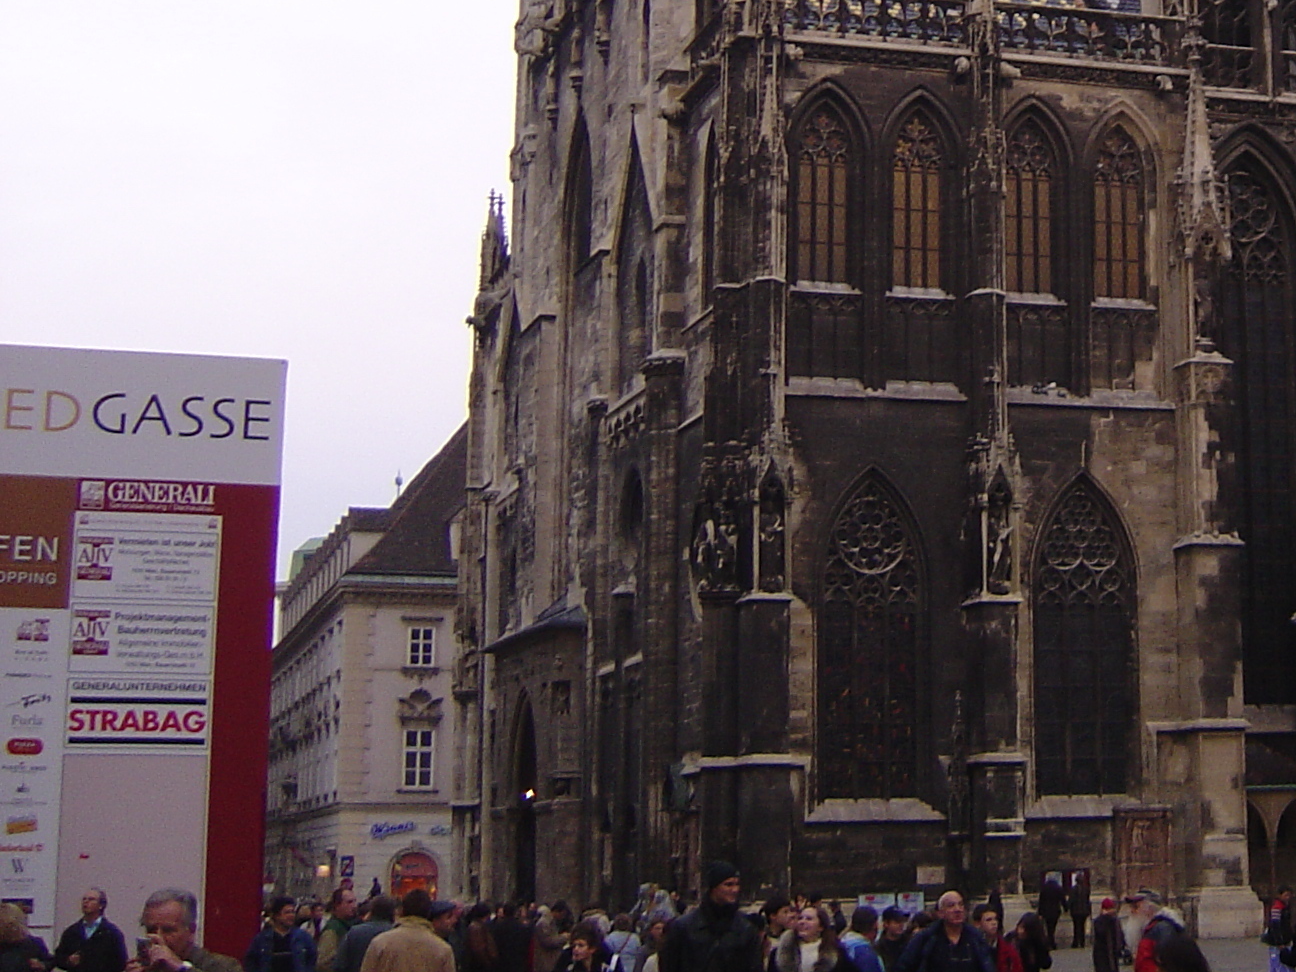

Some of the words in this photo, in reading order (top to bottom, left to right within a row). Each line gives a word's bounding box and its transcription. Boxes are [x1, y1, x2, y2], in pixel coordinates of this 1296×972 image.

[107, 481, 216, 505] GENERALI
[72, 681, 206, 692] GENERALUNTERNEHMEN
[68, 709, 206, 733] STRABAG
